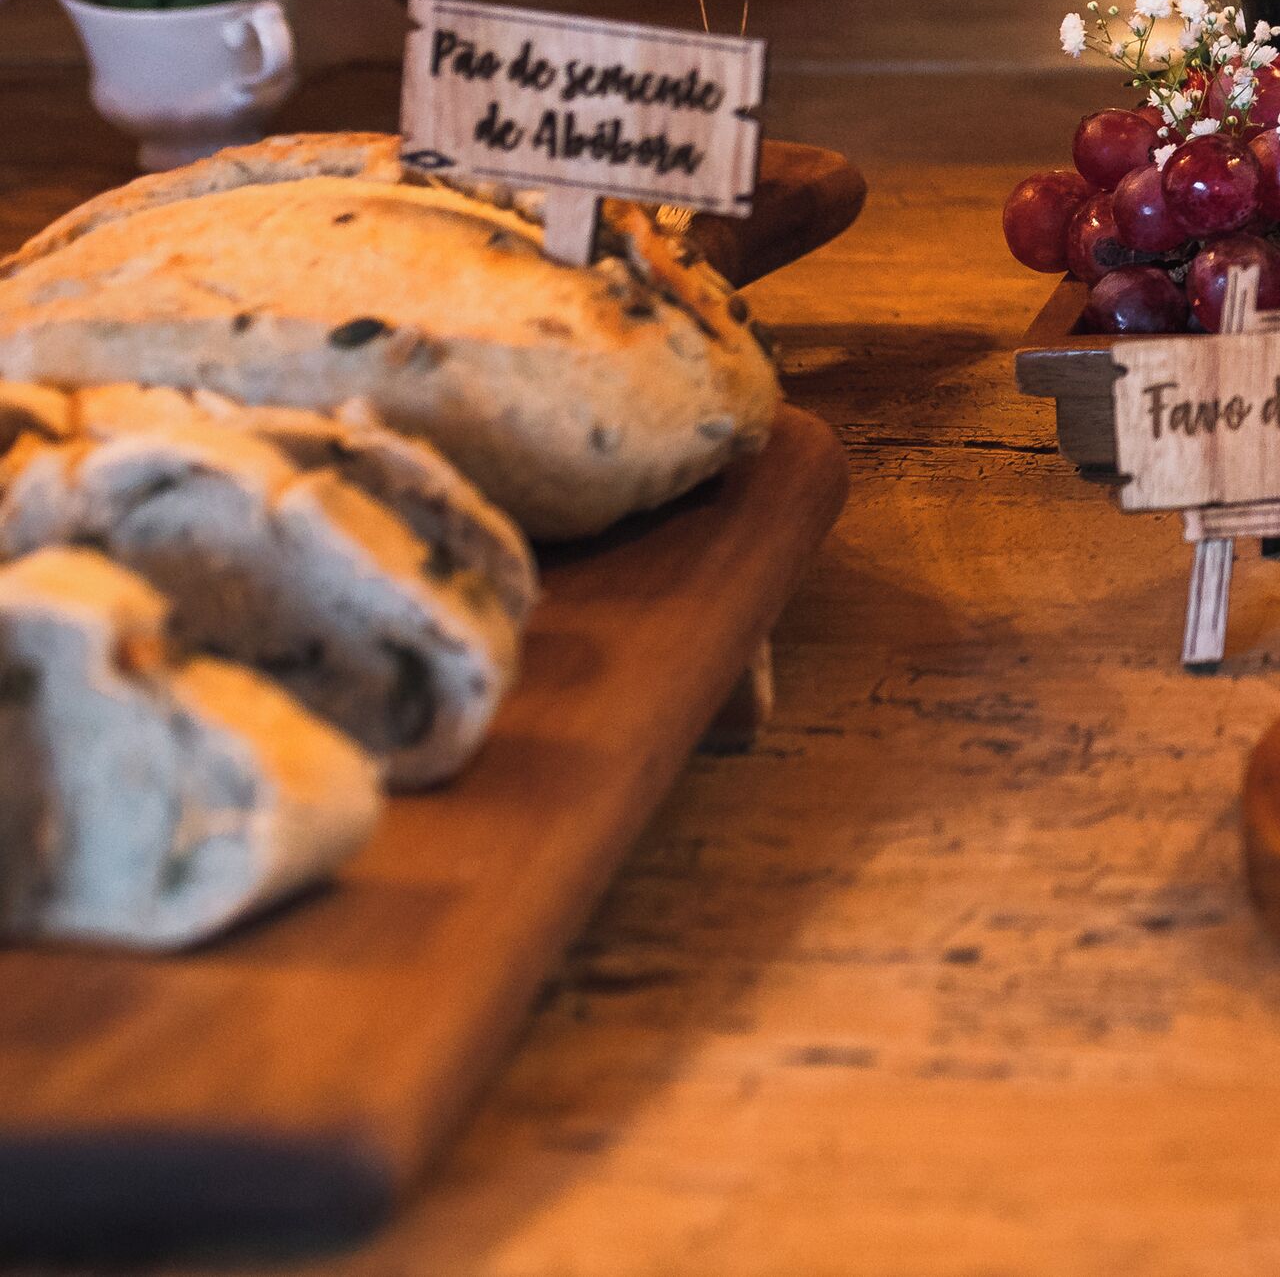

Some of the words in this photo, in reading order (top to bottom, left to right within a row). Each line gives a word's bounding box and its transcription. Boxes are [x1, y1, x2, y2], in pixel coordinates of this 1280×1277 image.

[561, 59, 726, 113] semente
[473, 101, 526, 152] de
[1143, 381, 1252, 441] Favo
